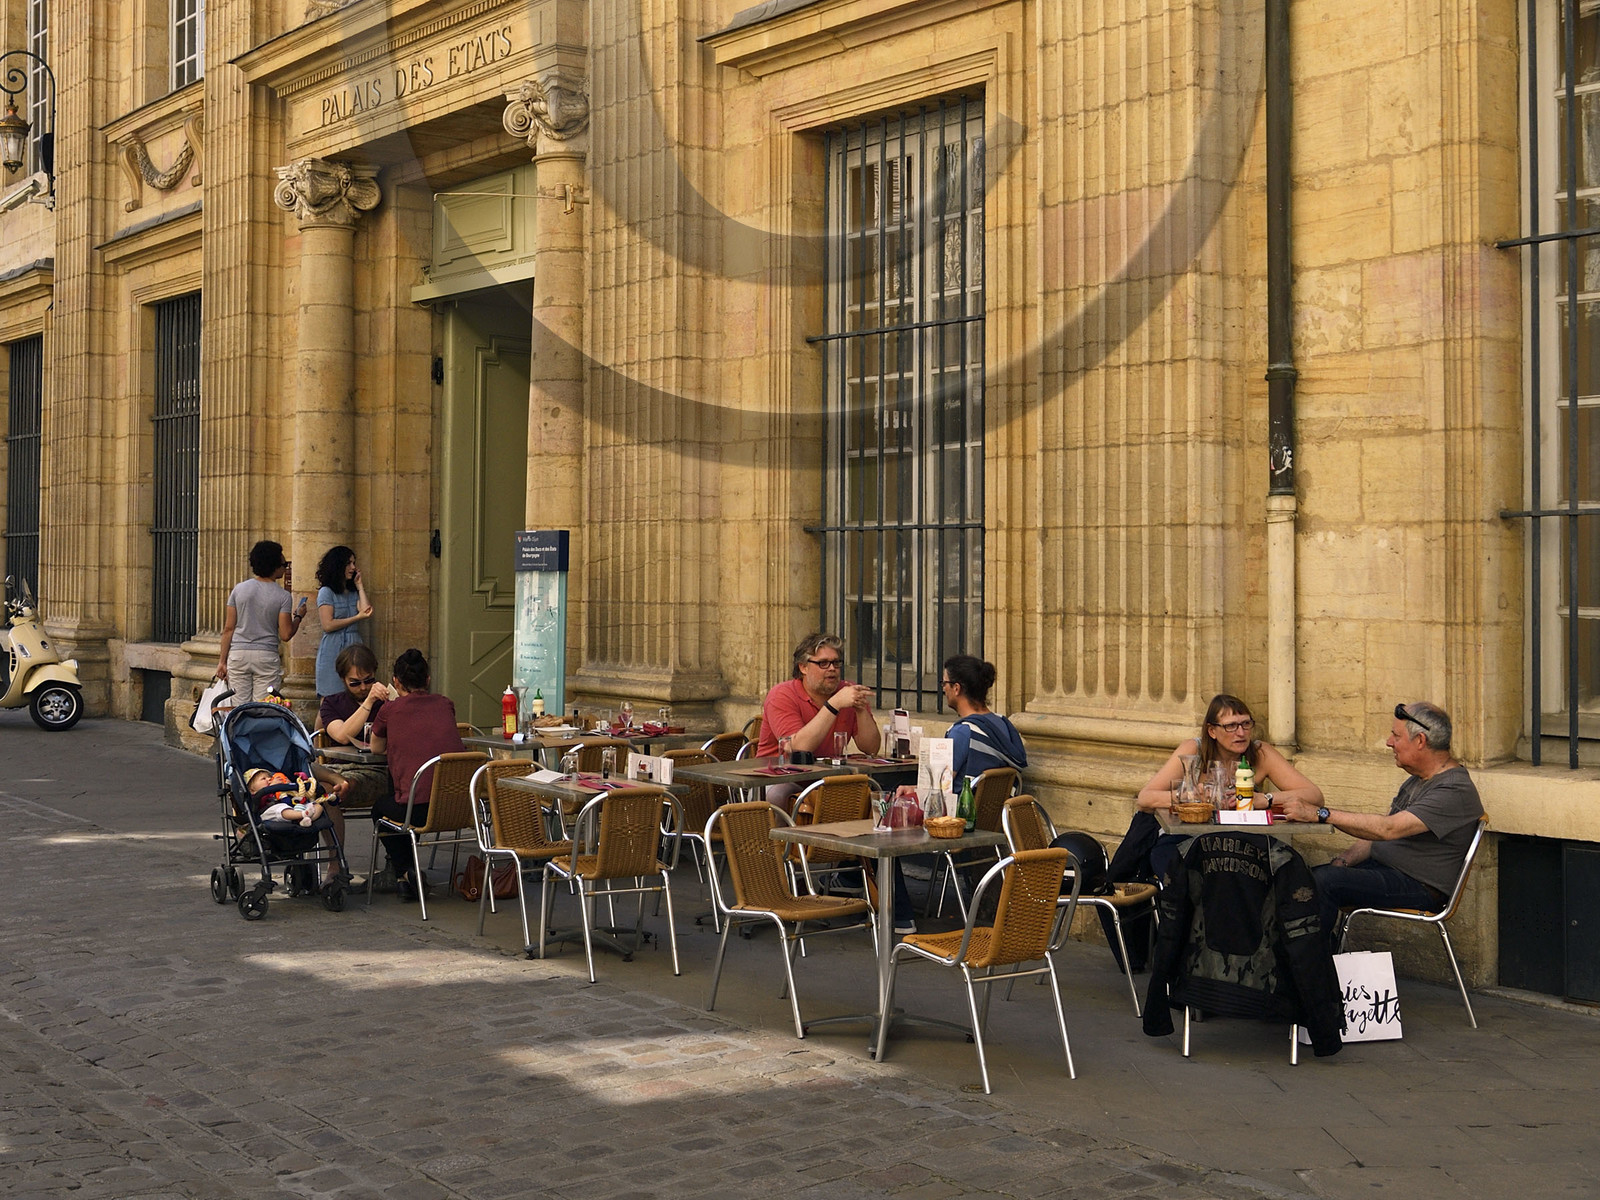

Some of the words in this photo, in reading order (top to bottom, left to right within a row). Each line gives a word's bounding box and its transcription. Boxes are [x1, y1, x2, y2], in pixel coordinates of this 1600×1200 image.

[320, 77, 383, 127] PALAIS
[394, 57, 435, 100] DES
[447, 25, 513, 80] ETATS
[1200, 836, 1268, 861] HARLEY
[1342, 979, 1372, 1002] ies
[1343, 989, 1402, 1036] fayette
